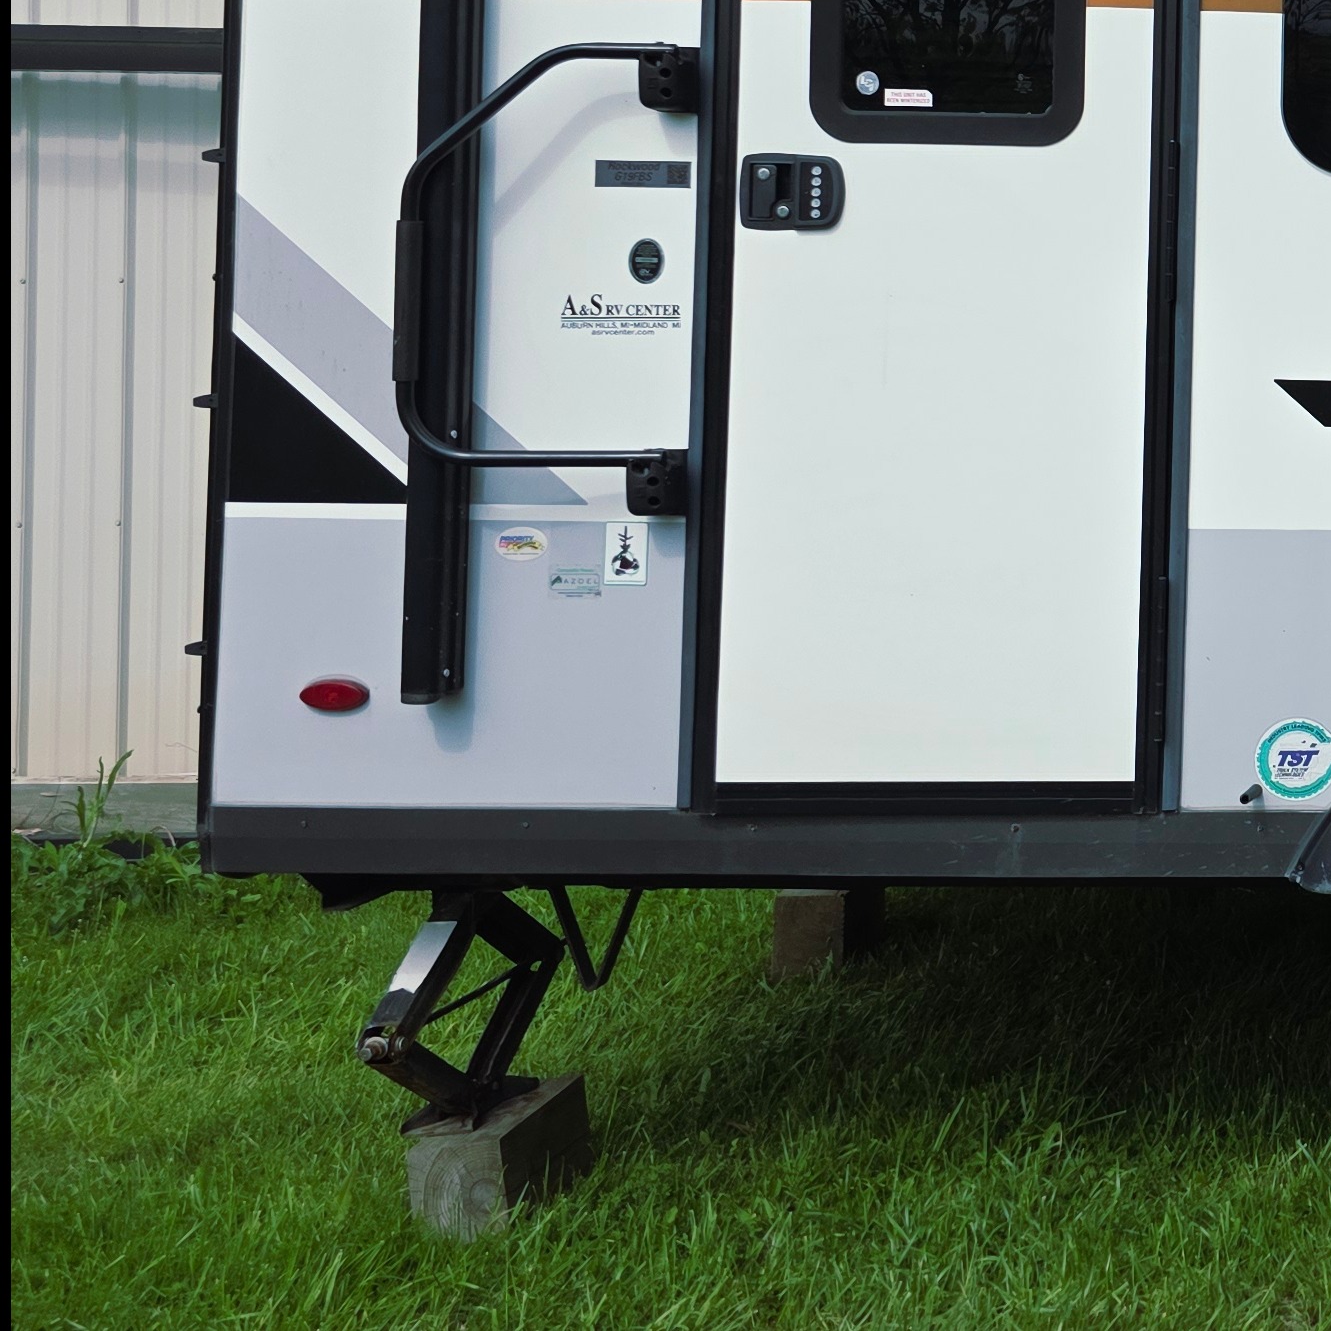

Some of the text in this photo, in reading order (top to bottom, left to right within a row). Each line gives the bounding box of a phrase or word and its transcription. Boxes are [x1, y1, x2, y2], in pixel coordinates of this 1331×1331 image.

[561, 293, 681, 317] A&S RV CENTER
[560, 321, 594, 329] AUBURN
[1267, 725, 1291, 744] INDUSTRY
[1291, 723, 1315, 733] LEADING
[1277, 750, 1320, 767] TST
